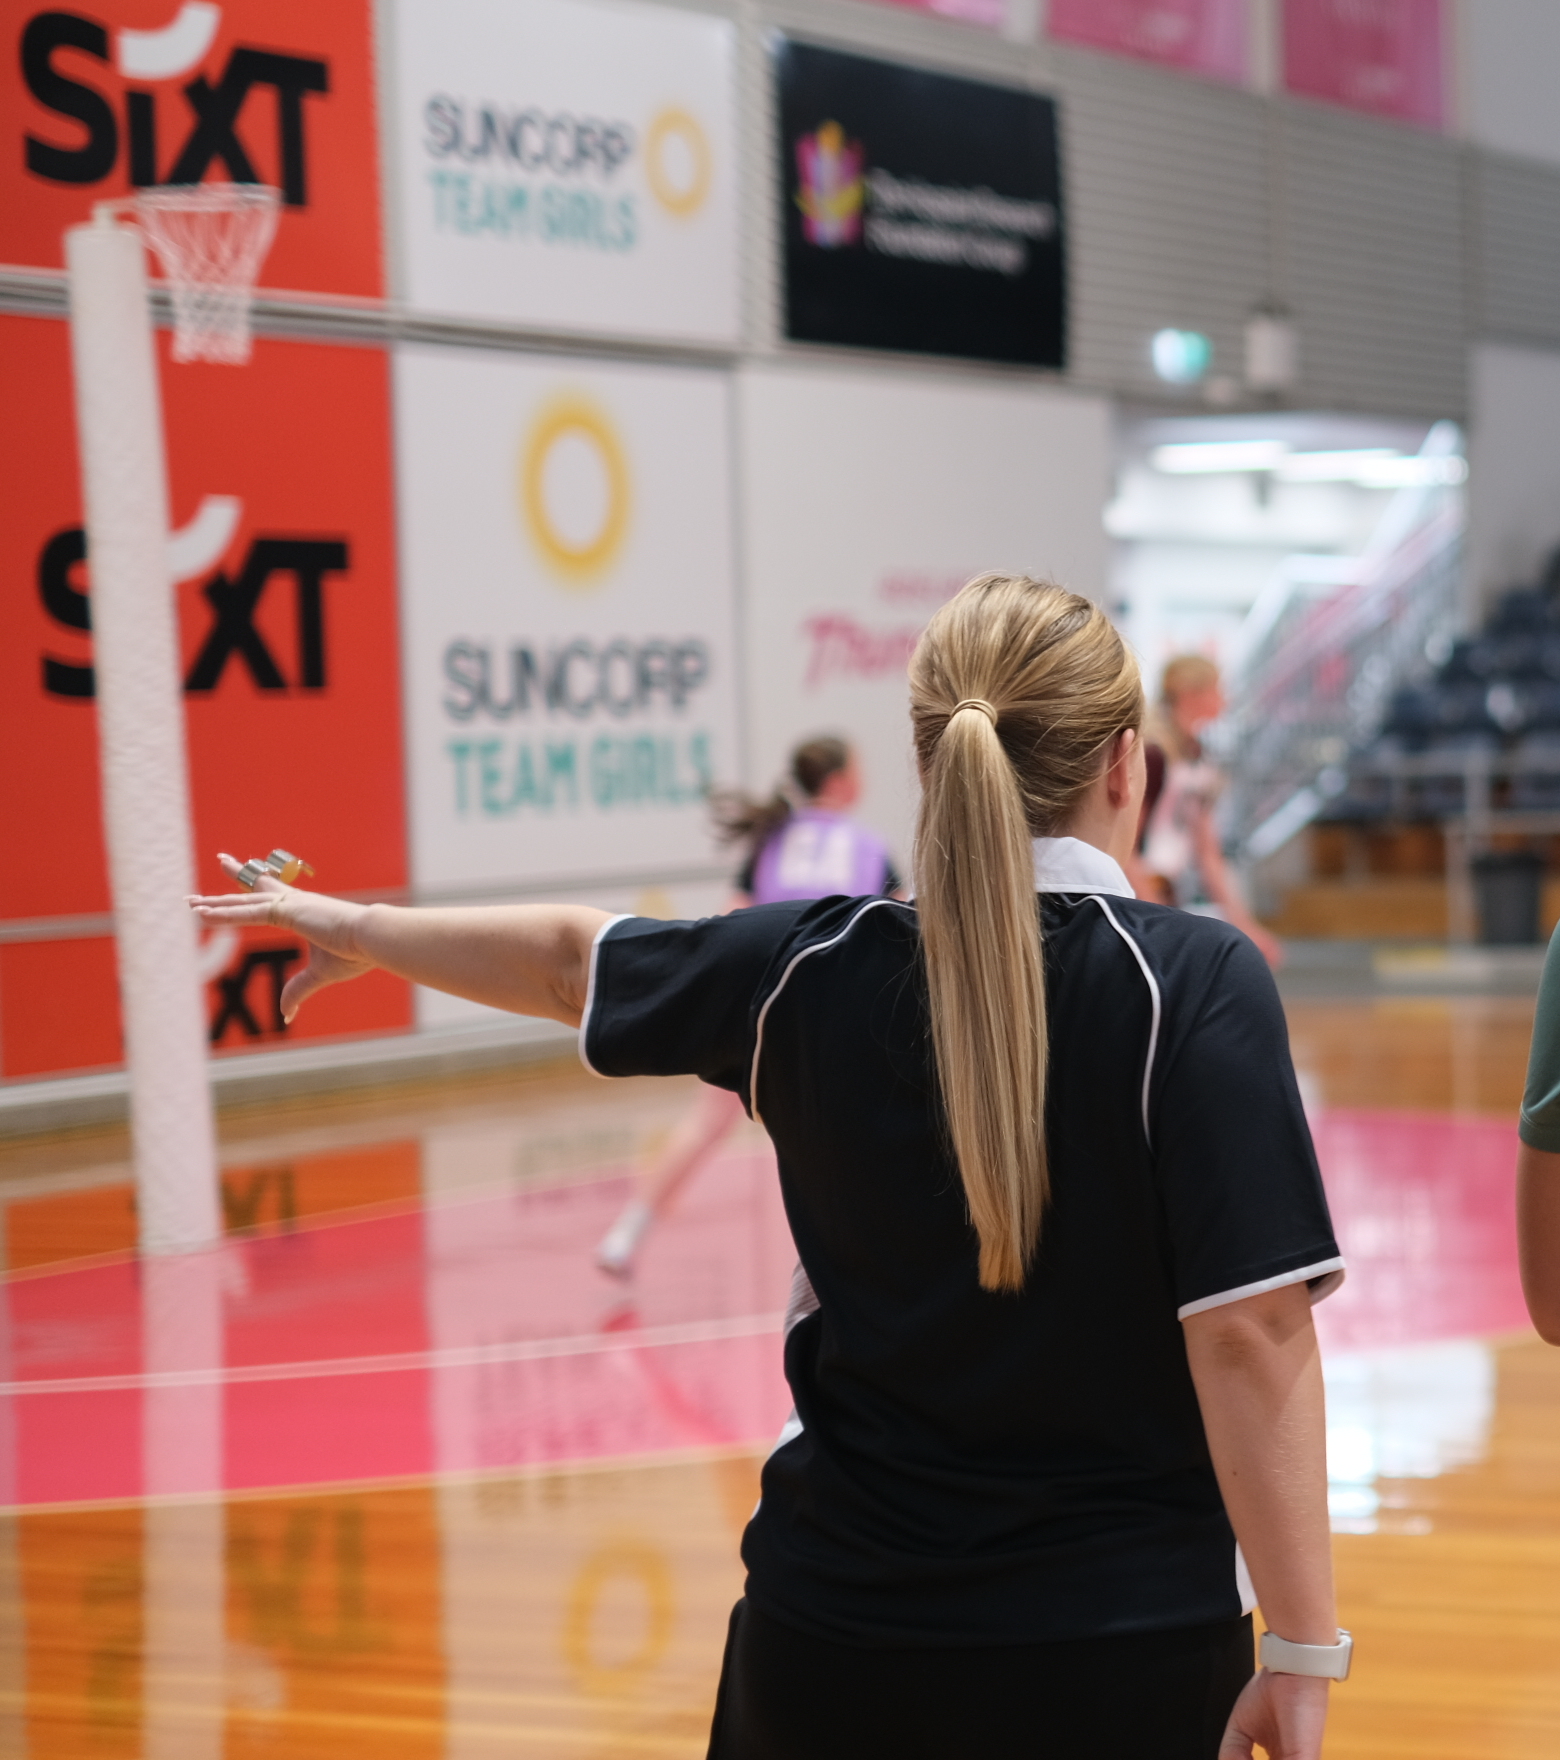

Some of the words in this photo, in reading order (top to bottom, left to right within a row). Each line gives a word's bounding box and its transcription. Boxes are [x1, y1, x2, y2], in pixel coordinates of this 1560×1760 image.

[19, 8, 330, 208] SIXT
[426, 97, 636, 178] SUNCORP
[430, 171, 530, 237] TEAM
[542, 187, 638, 254] GIRLS
[38, 526, 350, 700] SXT
[445, 638, 710, 719] SUNCORP
[449, 740, 579, 814] TEAM
[590, 734, 711, 807] GIRLS
[205, 946, 302, 1043] XT
